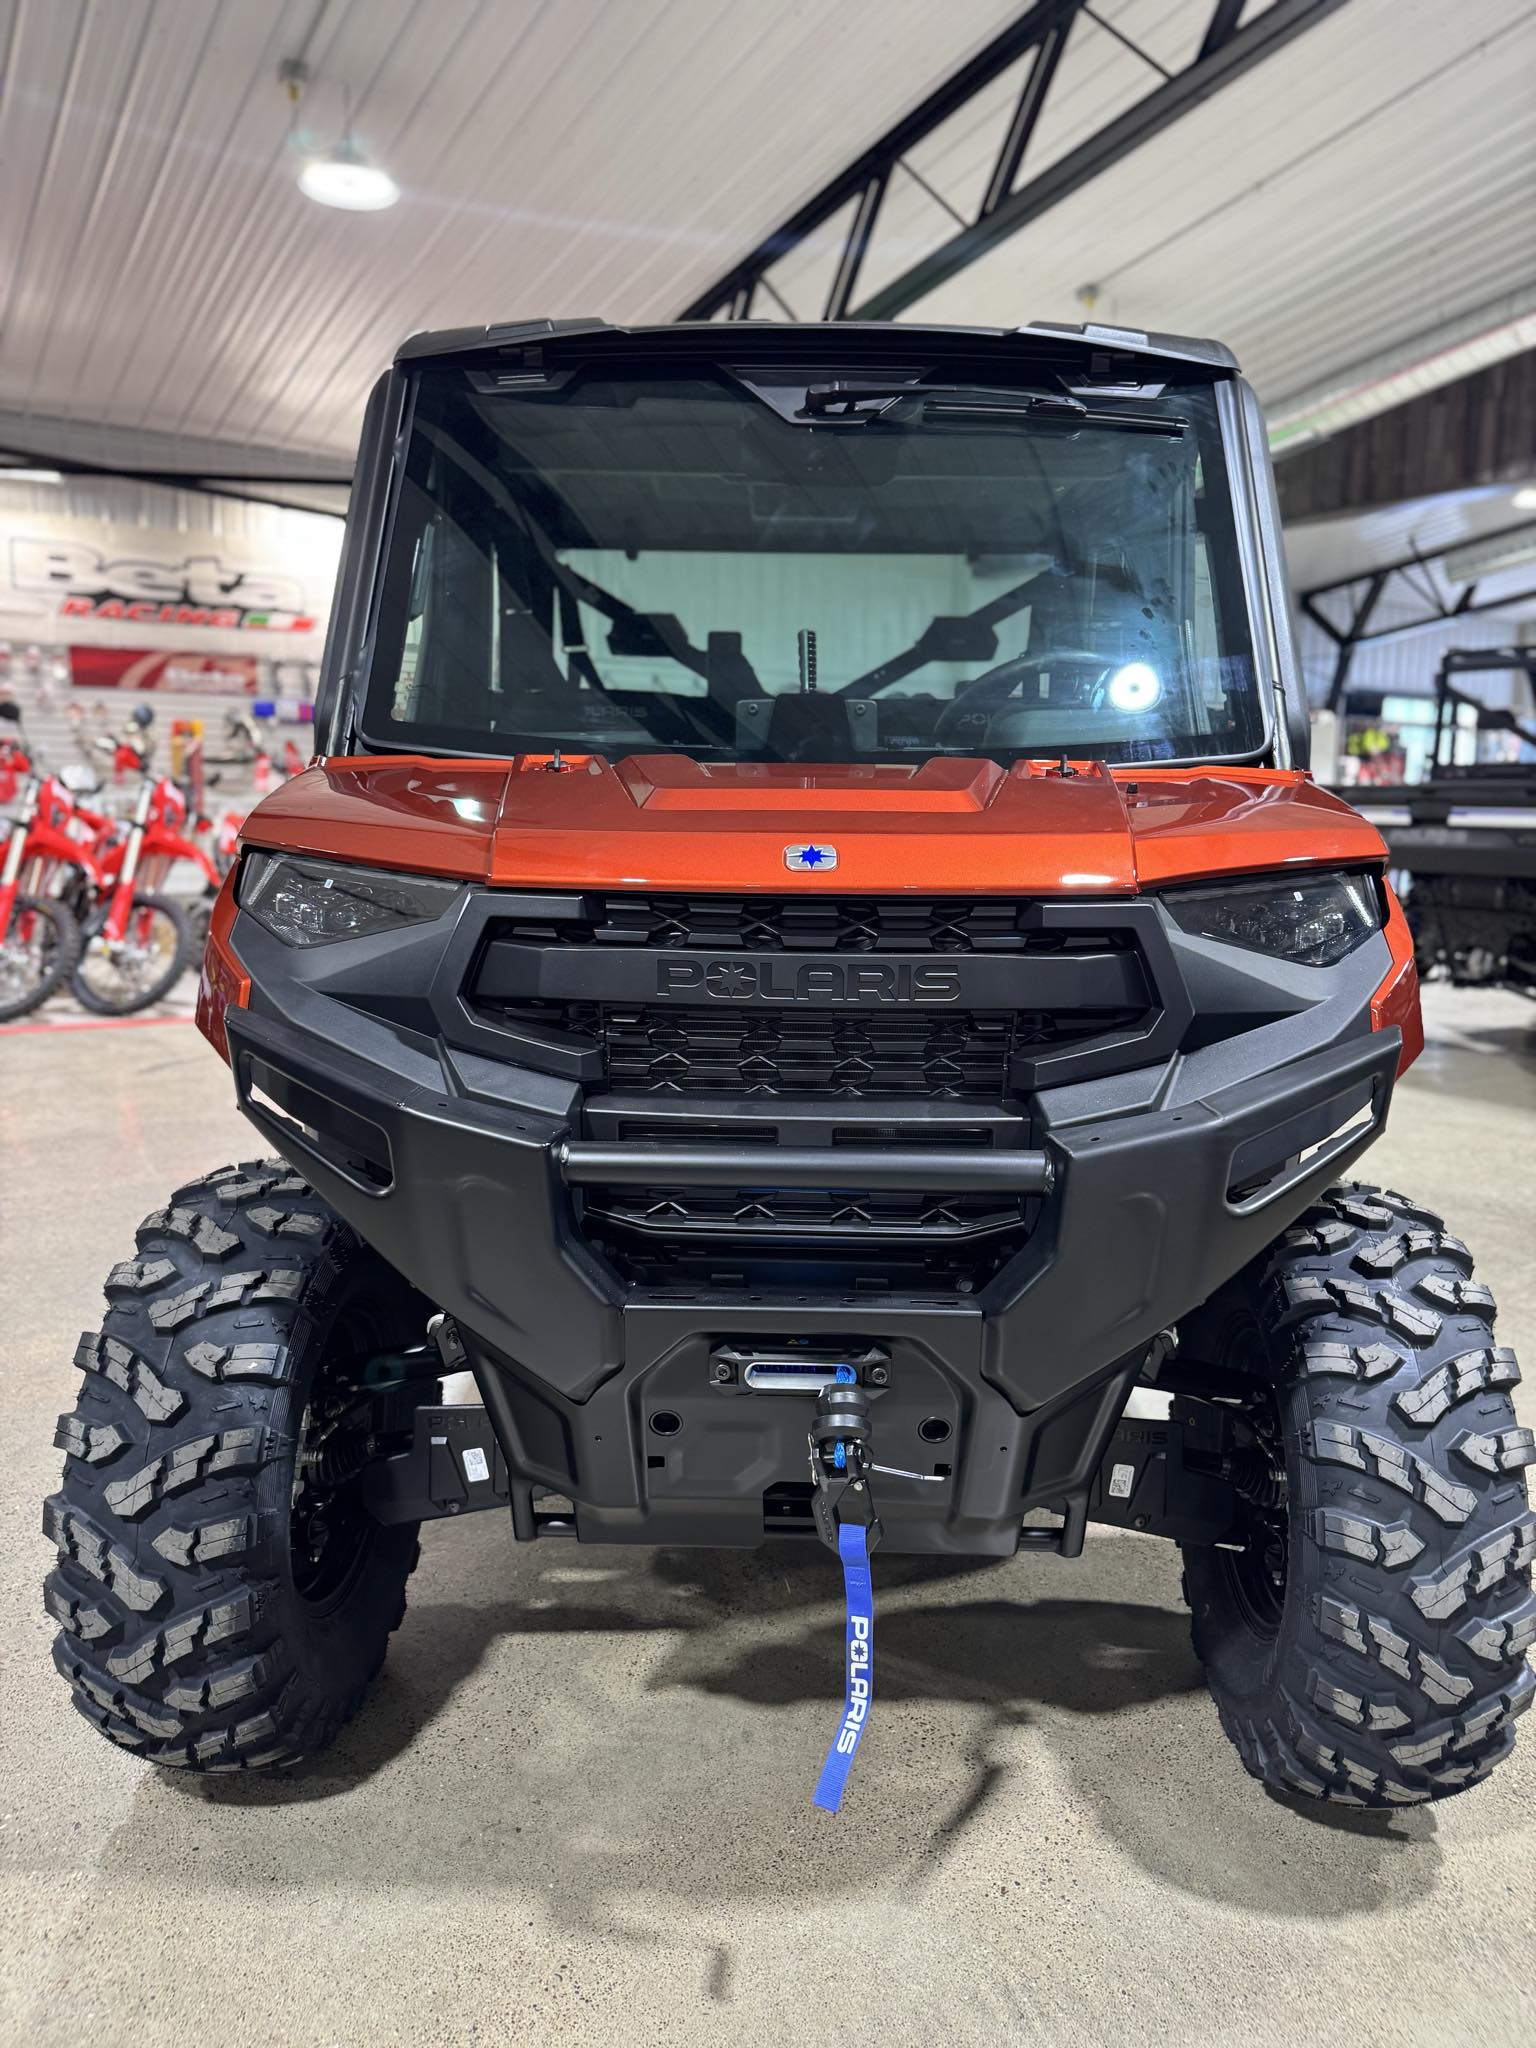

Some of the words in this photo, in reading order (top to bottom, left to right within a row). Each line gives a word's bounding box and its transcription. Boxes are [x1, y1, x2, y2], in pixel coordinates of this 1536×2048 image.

[9, 537, 305, 614] Beta
[60, 595, 241, 628] RACING
[657, 958, 962, 1001] POLARIS
[837, 1615, 868, 1755] POLARIS
